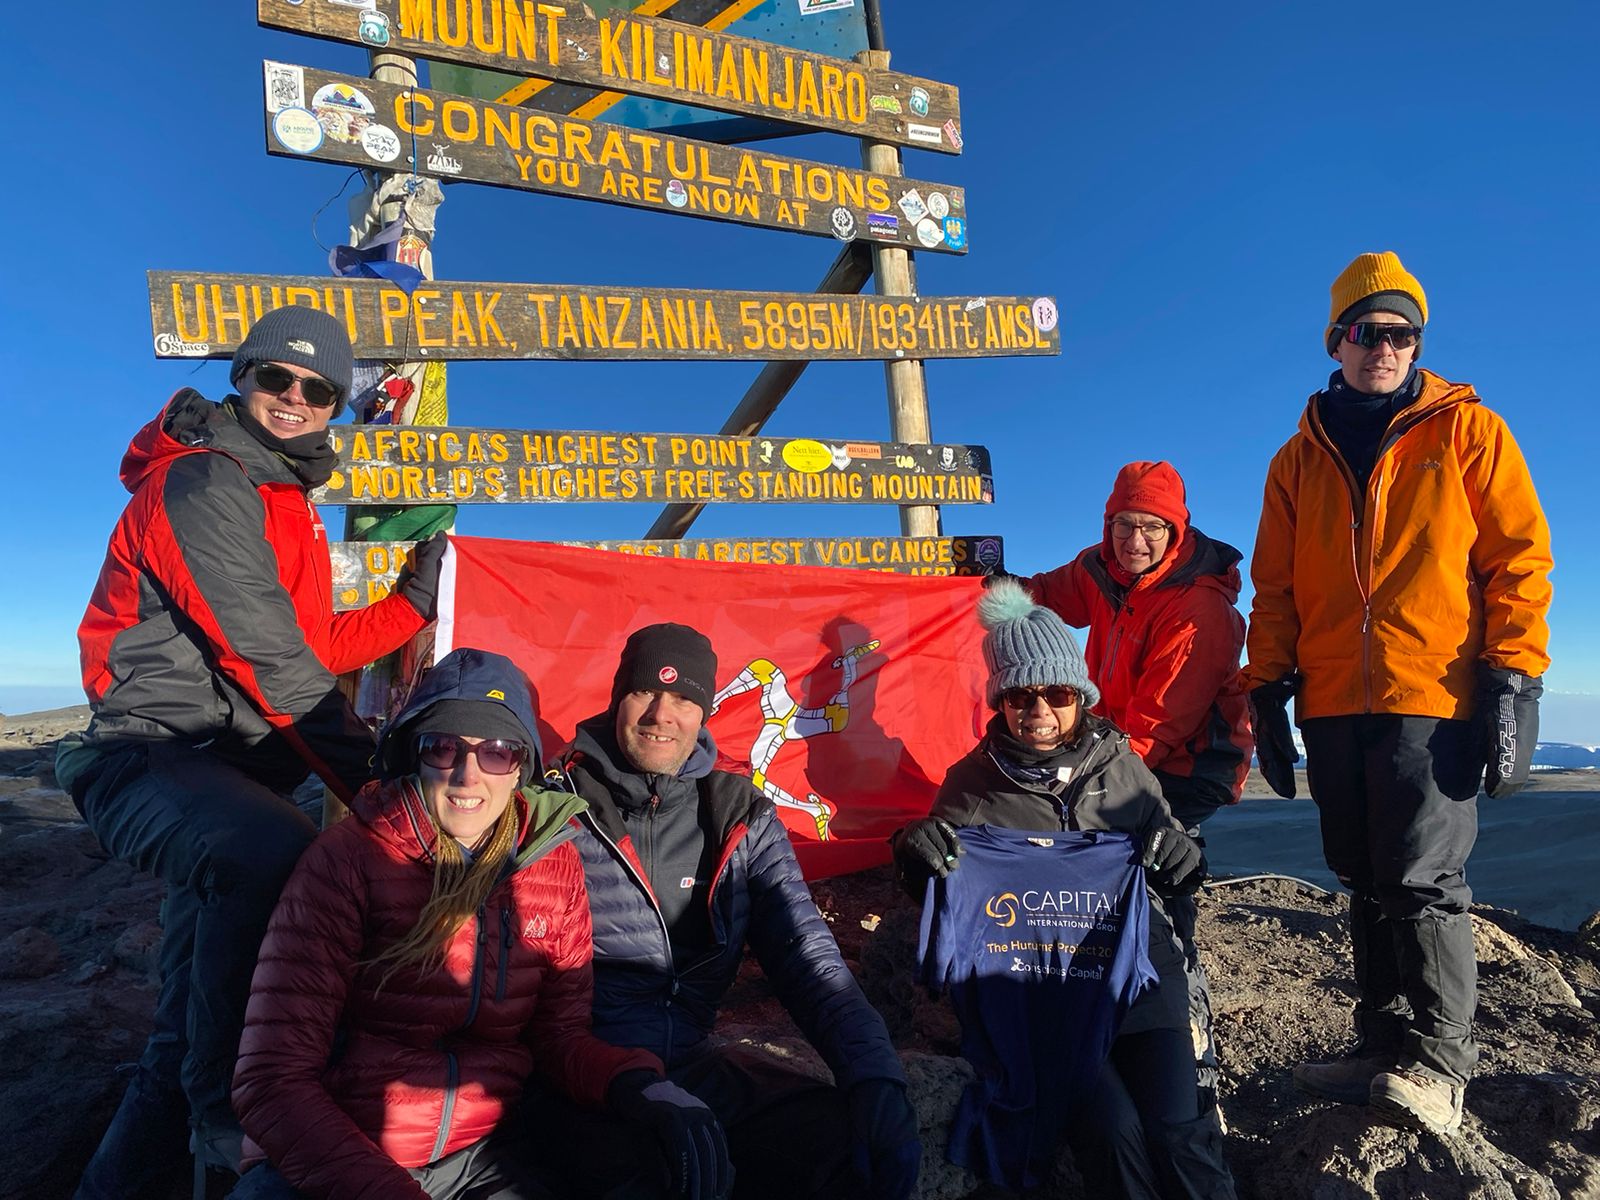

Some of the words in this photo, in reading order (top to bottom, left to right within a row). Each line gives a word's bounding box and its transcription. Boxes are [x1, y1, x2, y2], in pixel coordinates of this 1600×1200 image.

[400, 0, 568, 66] MOUNT
[599, 18, 869, 125] KILIMANJARO
[394, 92, 892, 213] CONGRATULATIONS
[514, 153, 581, 189] YOU
[600, 169, 665, 204] ARE
[686, 184, 761, 220] NOW
[777, 199, 809, 226] AT
[171, 282, 359, 345] UHU
[527, 293, 734, 354] TANZANIA,
[985, 303, 1051, 349] AMSL
[351, 430, 510, 464] AFRICA'S
[522, 434, 658, 465] HIGHEST
[670, 437, 753, 466] POINT
[350, 466, 504, 499] WORLD'S
[517, 466, 657, 498] HIGHEST
[870, 474, 982, 501] MOUNTAIN
[1022, 890, 1122, 917] CAPITAL
[1026, 919, 1094, 930] INTERNATIONAL
[987, 942, 1009, 955] The
[1057, 942, 1098, 956] Project
[1068, 964, 1103, 980] Capital
